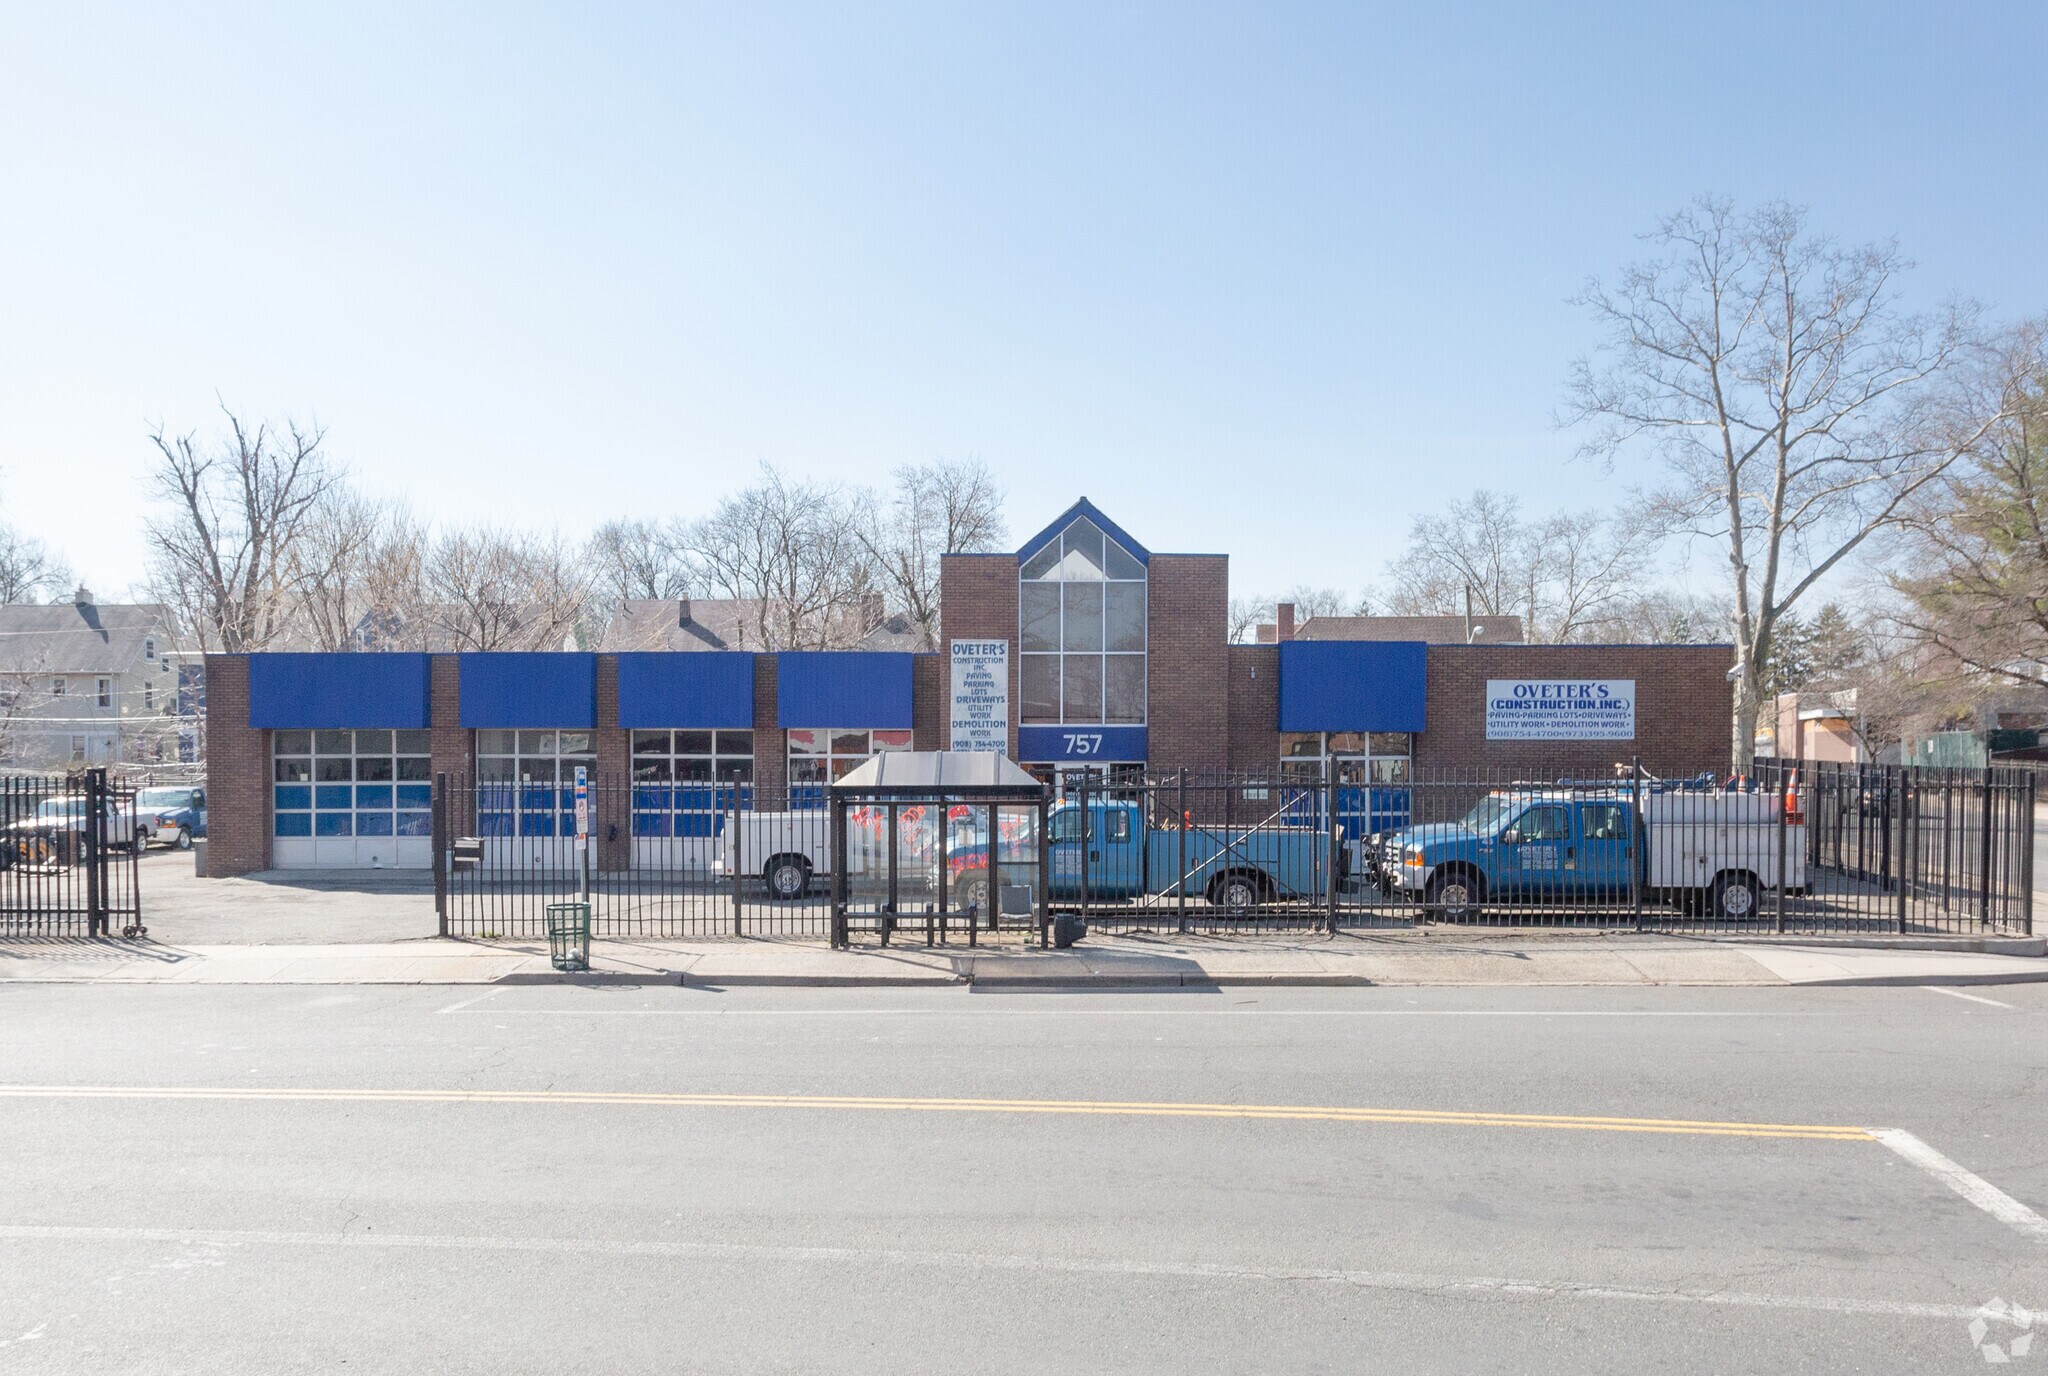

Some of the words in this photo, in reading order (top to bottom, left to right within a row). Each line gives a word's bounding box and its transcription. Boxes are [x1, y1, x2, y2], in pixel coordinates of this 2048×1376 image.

[953, 643, 1005, 655] OVETER'S
[966, 672, 992, 680] PAVING
[1513, 683, 1609, 698] OVETER'S
[956, 696, 1005, 704] DRIVEWAYS
[952, 720, 1006, 728] DEMOLITION
[970, 729, 992, 737] WORK
[1063, 734, 1103, 754] 757
